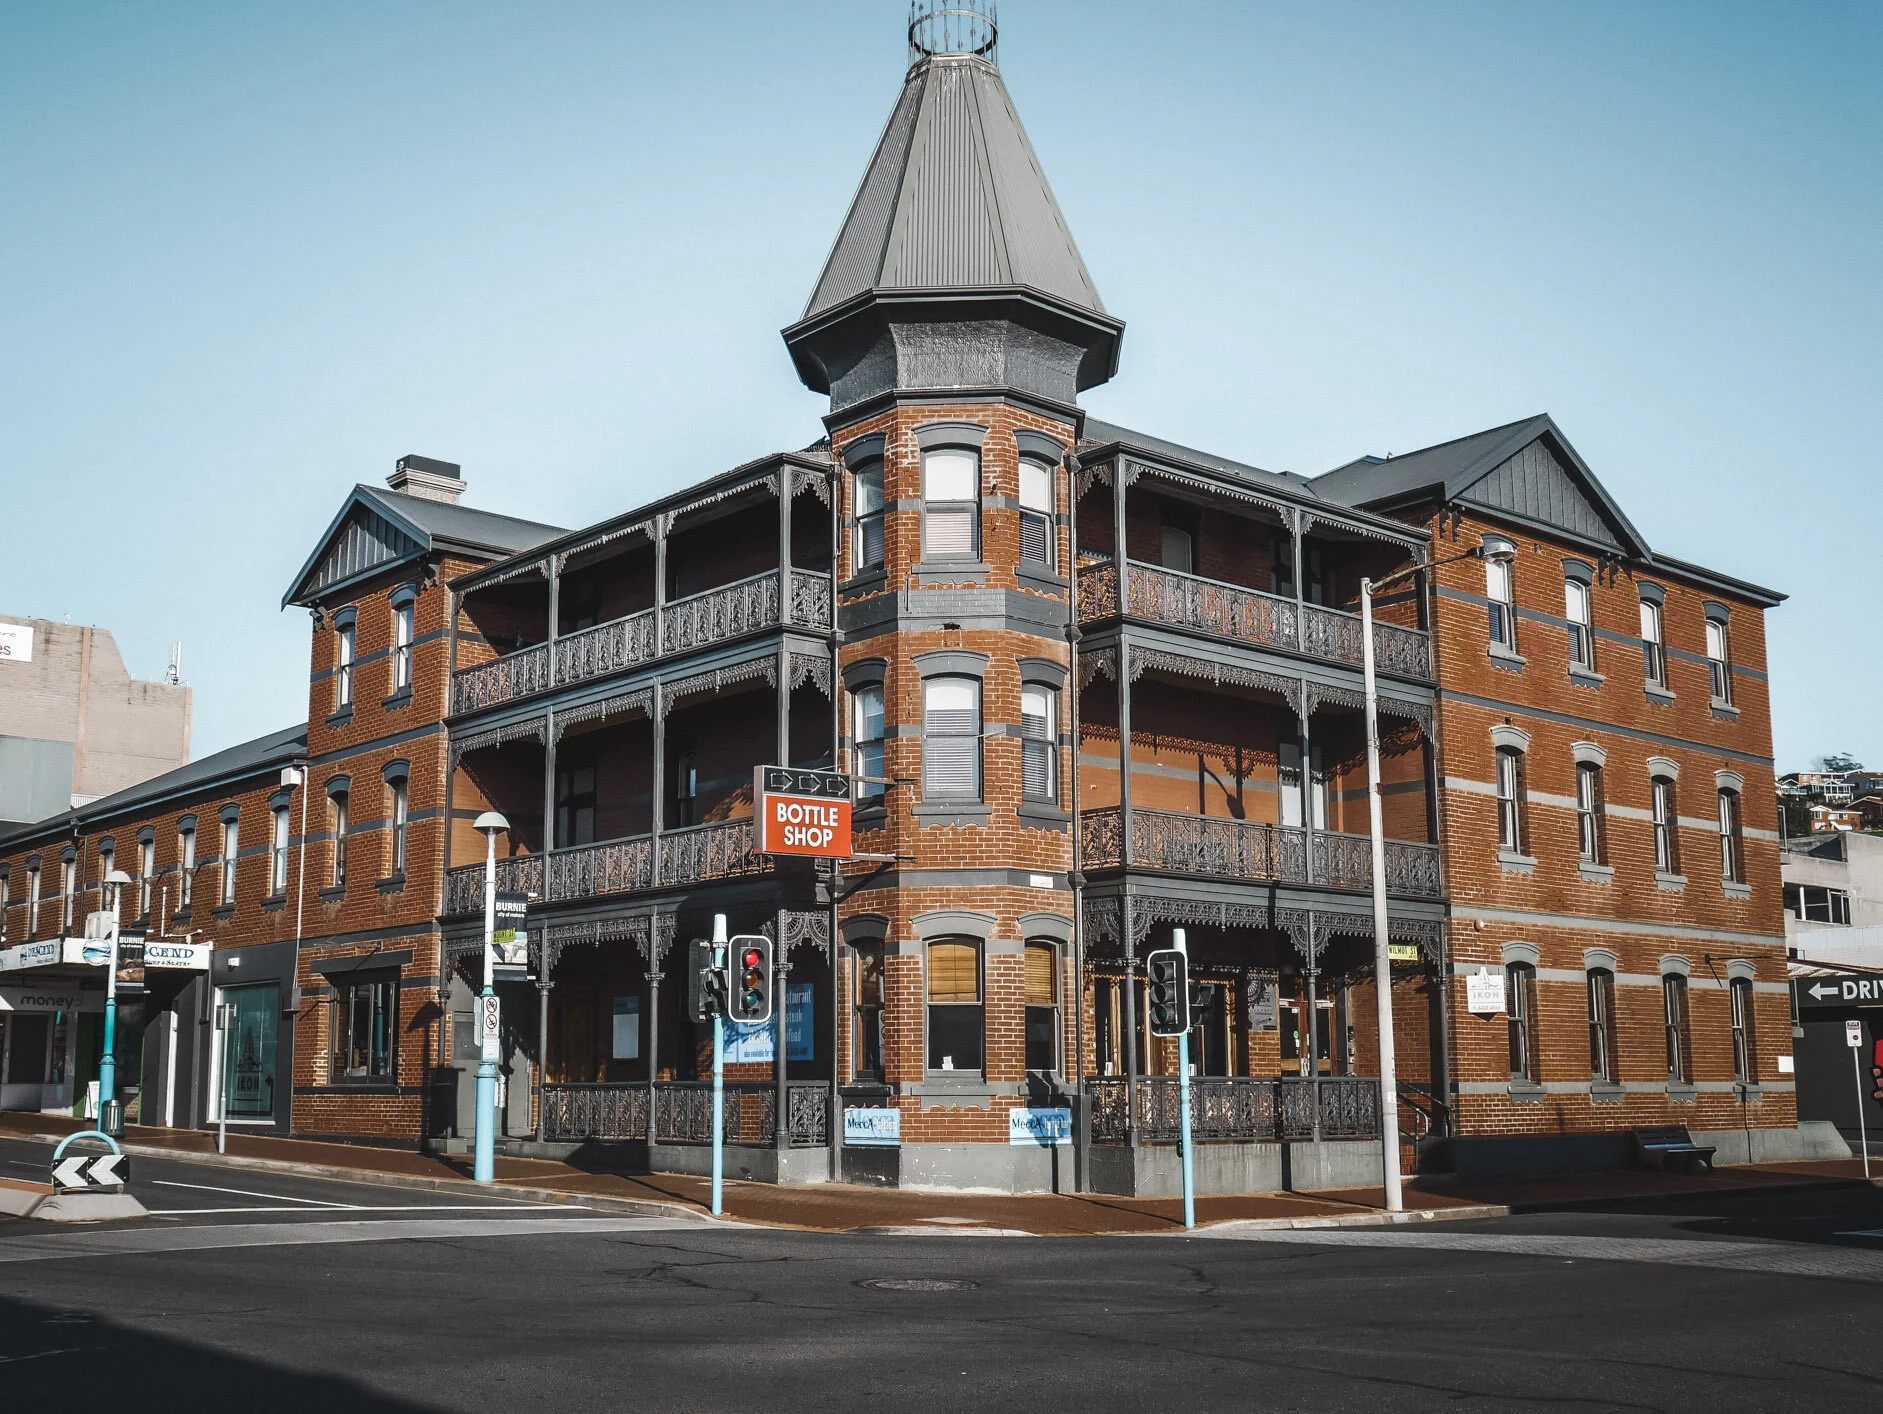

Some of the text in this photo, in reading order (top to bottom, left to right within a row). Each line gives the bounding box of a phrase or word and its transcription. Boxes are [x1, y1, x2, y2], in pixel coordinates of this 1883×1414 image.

[777, 802, 838, 826] BOTTLE
[784, 826, 833, 848] SHOP
[496, 902, 527, 912] BURNIE
[145, 945, 194, 958] CEND
[786, 989, 811, 1004] staurant
[1842, 980, 1883, 999] DRI
